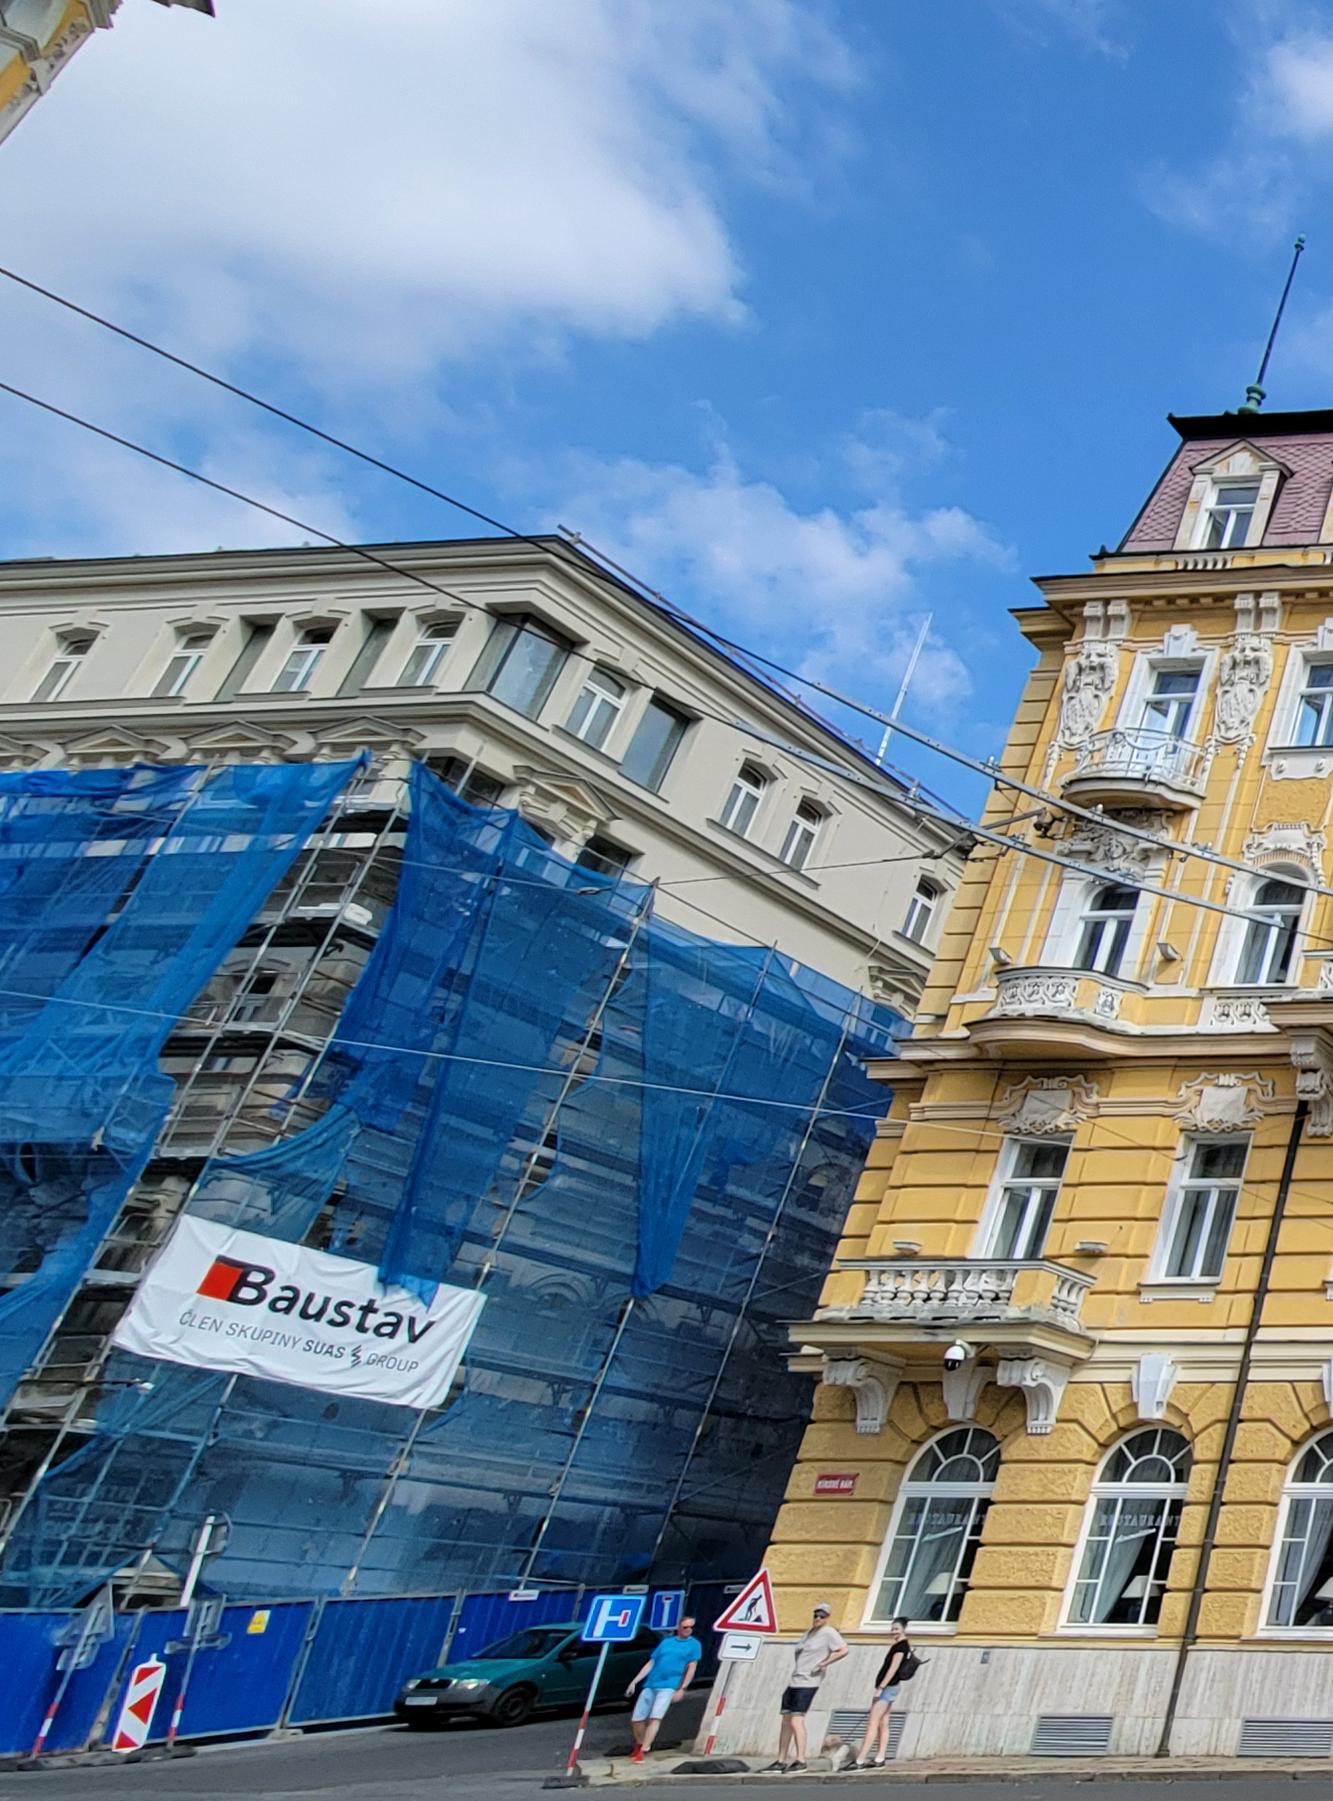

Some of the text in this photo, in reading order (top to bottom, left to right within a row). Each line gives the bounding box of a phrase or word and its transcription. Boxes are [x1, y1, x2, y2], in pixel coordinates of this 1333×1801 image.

[221, 1256, 436, 1344] Baustav
[225, 1322, 302, 1349] SKUPINY
[303, 1338, 347, 1360] SUAS
[366, 1352, 419, 1373] GROUP
